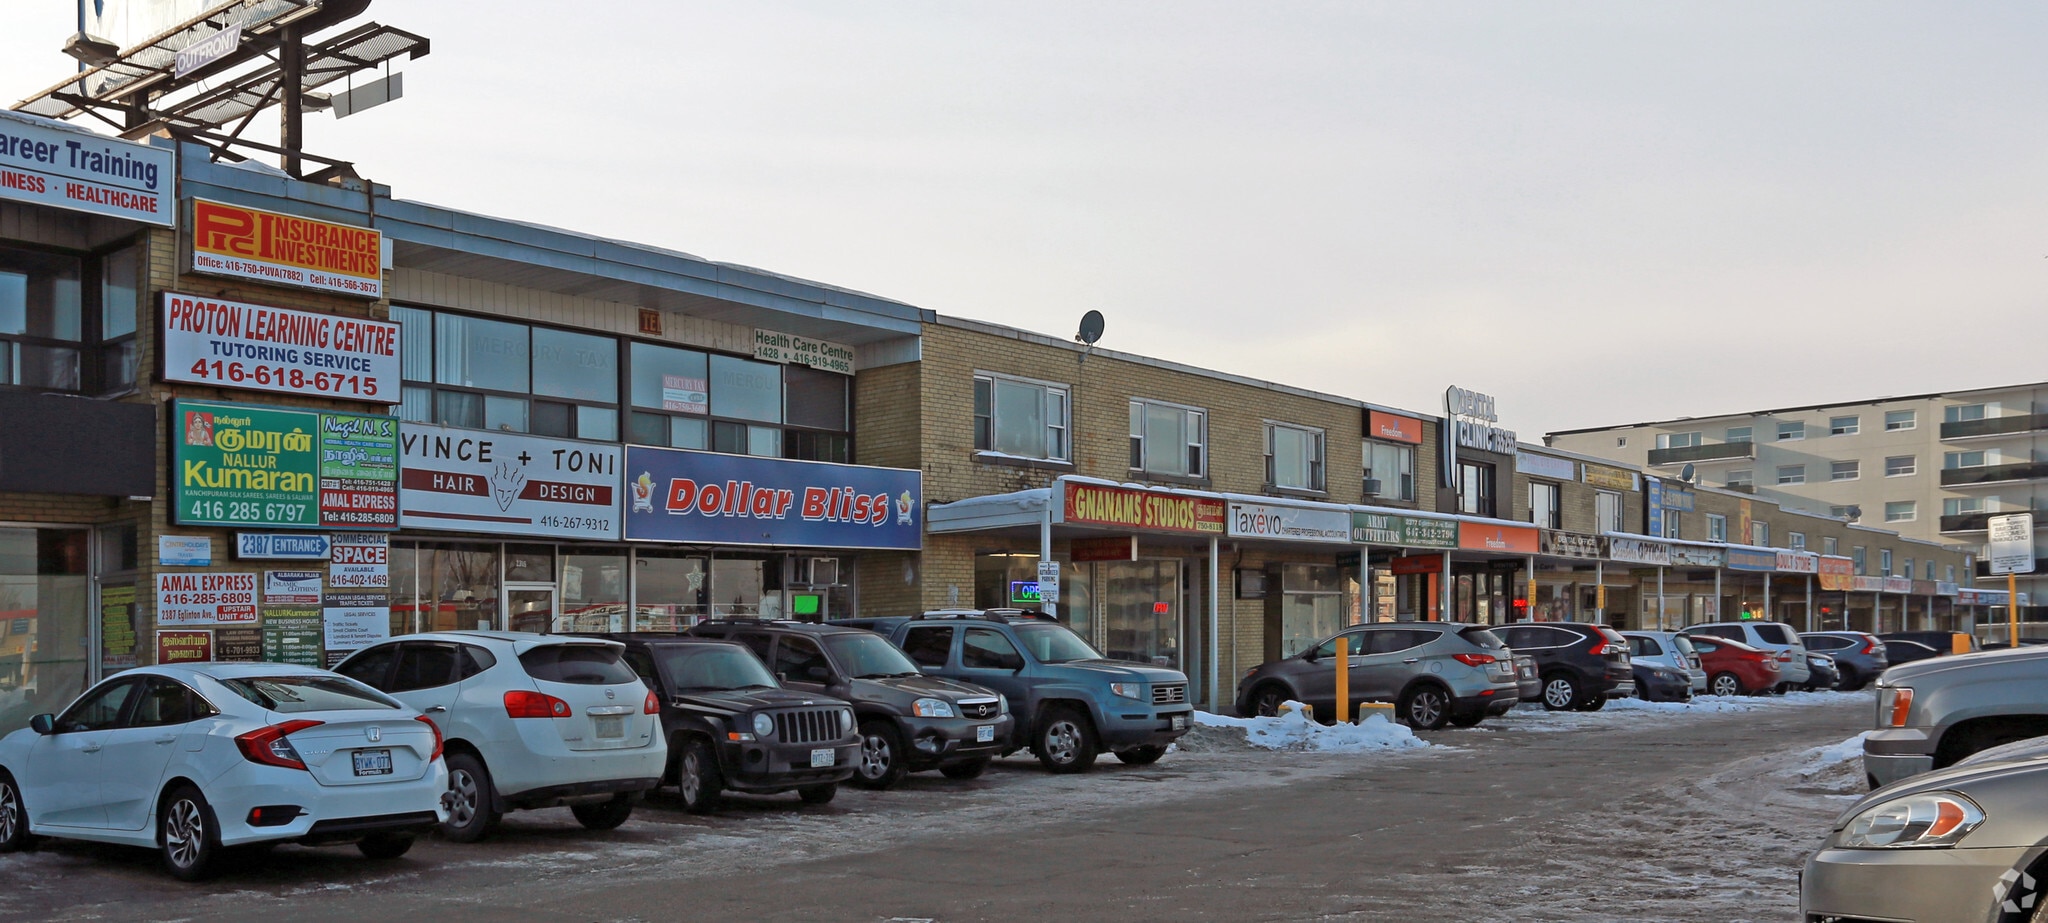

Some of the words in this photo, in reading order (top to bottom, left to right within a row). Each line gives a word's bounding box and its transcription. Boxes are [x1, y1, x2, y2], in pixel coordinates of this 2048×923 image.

[178, 27, 238, 70] OUTFRONT
[66, 140, 157, 189] Training
[0, 170, 45, 193] INESS
[66, 182, 157, 213] HEALTHCARE
[197, 255, 224, 269] Office:
[225, 260, 303, 282] 416-750-PUVA(7882)
[310, 273, 327, 285] Cell:
[328, 278, 377, 293] 416-566-3673
[169, 298, 242, 338] PROTON
[245, 308, 329, 349] LEARNING
[333, 320, 396, 357] CENTRE
[755, 330, 790, 349] Health
[792, 337, 817, 353] Care
[820, 344, 853, 361] Centre
[210, 340, 298, 363] TUTORING
[303, 351, 371, 372] SERVICE
[575, 350, 610, 369] TAX
[754, 347, 779, 360] -1428
[793, 353, 849, 372] 416-919-4965
[191, 358, 378, 396] 416-618-6715
[1458, 387, 1498, 422] DENTAL
[324, 416, 360, 438] Nagil
[362, 420, 377, 435] N.
[380, 421, 393, 437] S.
[1381, 424, 1403, 438] Freedom
[1459, 420, 1493, 451] CLINIC
[215, 427, 313, 454] குமரன்
[223, 453, 277, 469] NALLUR
[401, 432, 493, 463] VINCE
[518, 450, 531, 466] +
[552, 448, 614, 475] TONI
[184, 459, 314, 493] Kumaran
[265, 492, 286, 500] SAREES
[433, 474, 475, 492] HAIR
[539, 483, 595, 502] DESIGN
[191, 500, 224, 519] 416
[229, 501, 260, 520] 285
[265, 503, 306, 521] 6797
[322, 492, 350, 508] AMAL
[352, 494, 395, 510] EXPRESS
[665, 477, 795, 520] Dollar
[801, 486, 889, 527] Bliss
[1075, 487, 1142, 525] GNANAMS
[1145, 496, 1195, 529] STUDIOS
[323, 511, 338, 521] Tel:
[340, 512, 394, 523] 416-285-6809
[540, 516, 610, 531] 416-267-9312
[1231, 506, 1281, 535] Taxëvo
[1366, 515, 1388, 529] ARMY
[331, 534, 387, 544] COMMERCIAL
[1353, 527, 1400, 543] OUTFITTERS
[1405, 527, 1455, 539] 647-342-2796
[1485, 536, 1506, 548] Freedom
[1577, 538, 1596, 546] OFFICE
[242, 535, 270, 554] 2387
[274, 539, 321, 553] ENTRANCE
[1637, 542, 1668, 562] OPTICAL
[332, 546, 386, 563] SPACE
[1794, 556, 1811, 571] STORE
[161, 575, 198, 592] AMAL
[201, 574, 254, 591] EXPRESS
[331, 574, 387, 585] 416-402-1469
[163, 592, 252, 605] 416-285-6809
[1022, 585, 1040, 599] OPE
[161, 609, 176, 620] 2387
[222, 605, 252, 613] UPSTAIR
